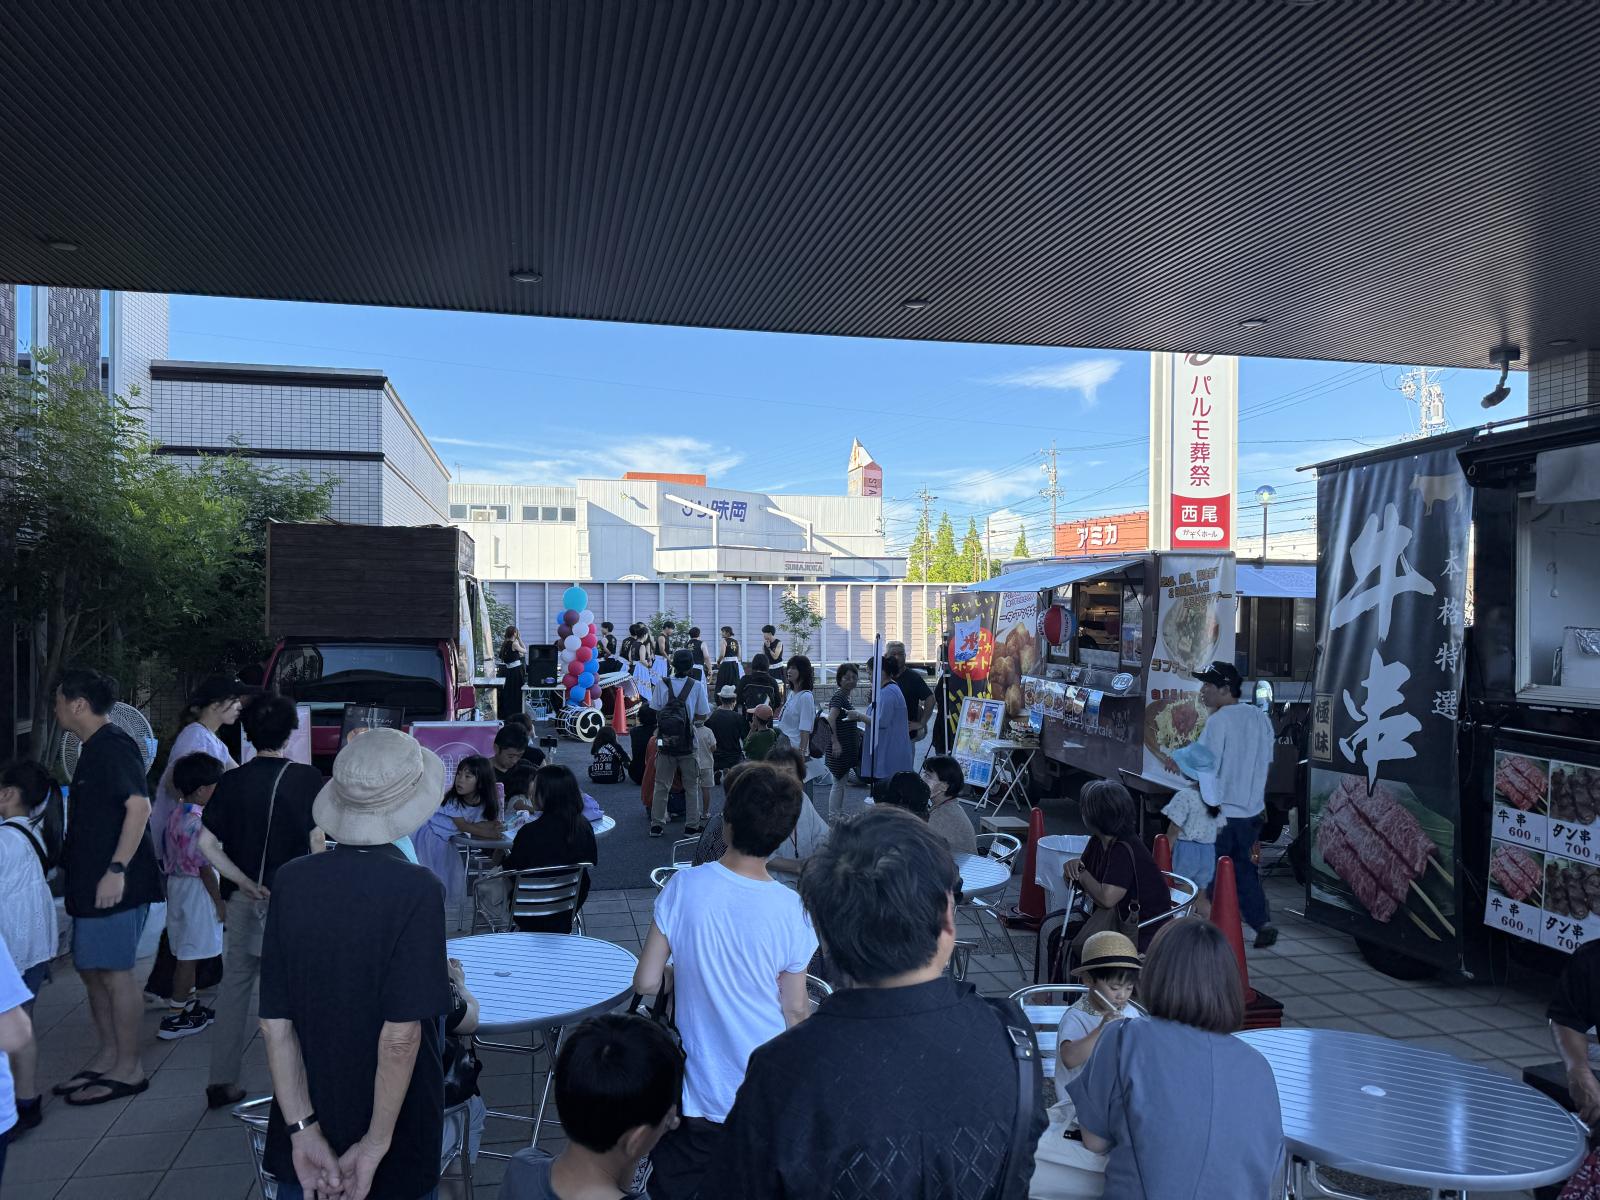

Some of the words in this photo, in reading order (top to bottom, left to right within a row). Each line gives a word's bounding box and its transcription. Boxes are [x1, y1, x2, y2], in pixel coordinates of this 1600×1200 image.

[1190, 375, 1212, 487] パルモ葬祭
[1181, 505, 1218, 522] 西尾
[1076, 522, 1119, 549] アミカ
[1432, 550, 1463, 720] 本格特選
[1330, 502, 1436, 797] 牛串
[1498, 809, 1526, 827] 牛串
[1509, 827, 1531, 840] 600
[1553, 824, 1591, 845] タン串
[1565, 842, 1590, 857] 700
[1491, 897, 1520, 917] 牛串
[1501, 915, 1523, 931] 600
[1546, 916, 1584, 940] タン串
